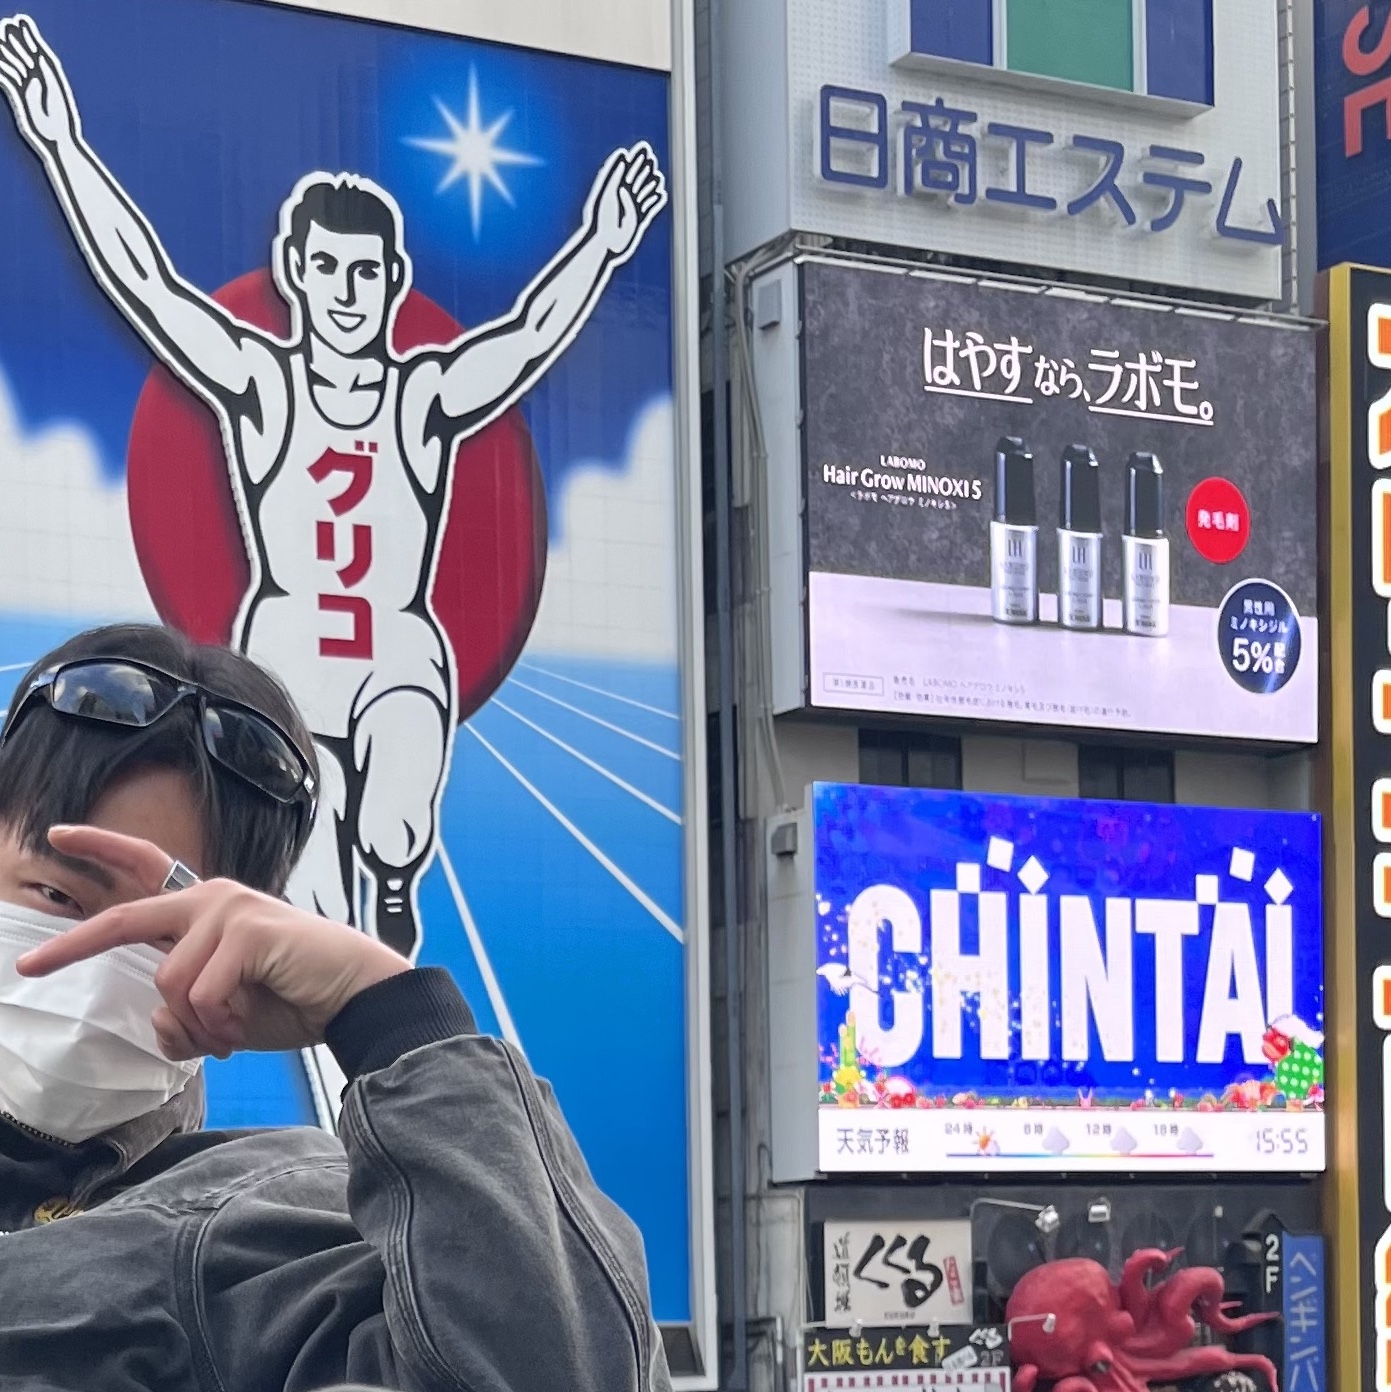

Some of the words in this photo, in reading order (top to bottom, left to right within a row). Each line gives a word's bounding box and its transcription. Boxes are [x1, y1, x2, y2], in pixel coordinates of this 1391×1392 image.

[819, 84, 1284, 246] 日商エステム
[923, 326, 1215, 422] はやすなら、ラボモ。
[823, 464, 860, 486] Hair
[860, 468, 906, 491] Grow
[880, 454, 927, 471] LABOMO
[1197, 508, 1240, 533] 発毛剤
[306, 439, 378, 661] グリコ
[1230, 615, 1288, 634] ミノキシジル
[847, 855, 1294, 1067] CHINTAI
[836, 1126, 910, 1155] 天気予報
[1254, 1128, 1309, 1154] 15:55
[853, 1234, 944, 1309] くくる
[1265, 1233, 1280, 1294] 2F
